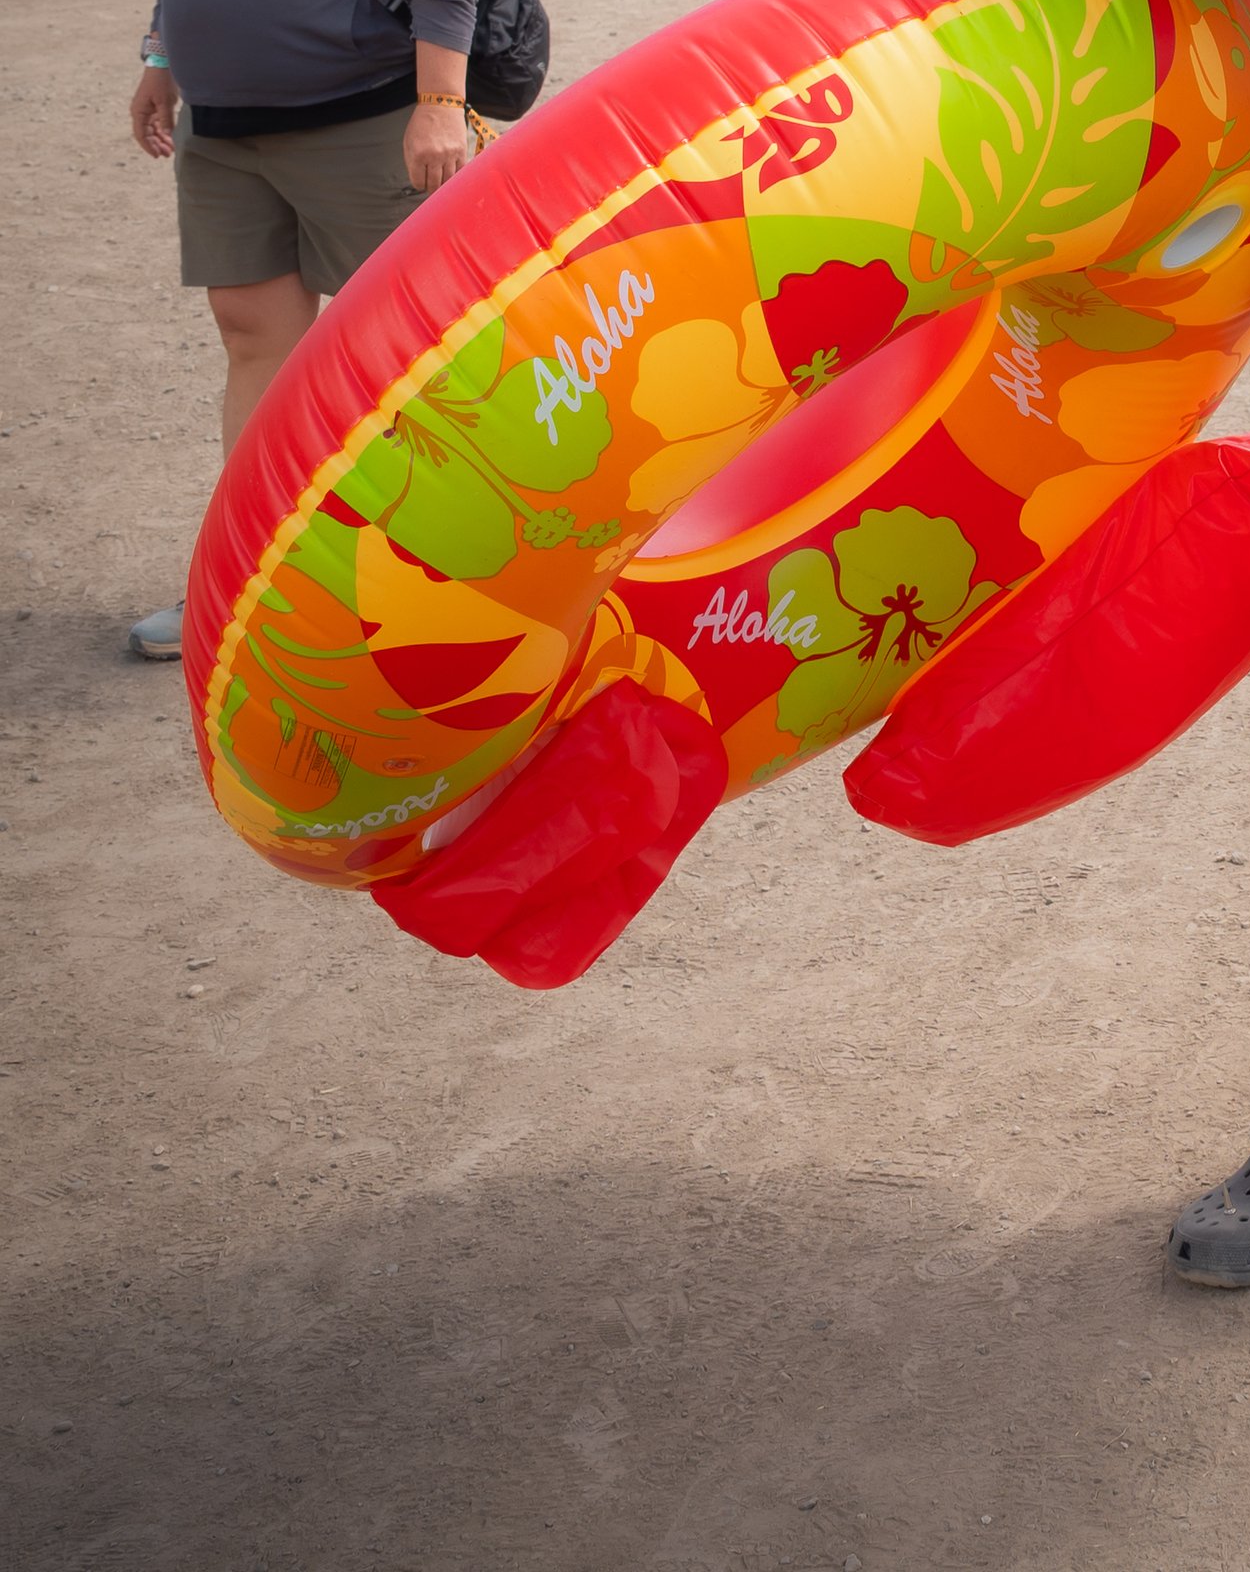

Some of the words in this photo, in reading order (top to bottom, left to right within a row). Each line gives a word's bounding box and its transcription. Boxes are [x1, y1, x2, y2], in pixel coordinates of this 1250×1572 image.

[535, 269, 655, 446] Aloha
[990, 304, 1053, 425] Aloha
[687, 586, 822, 650] Aloha
[295, 776, 449, 840] Aloha
